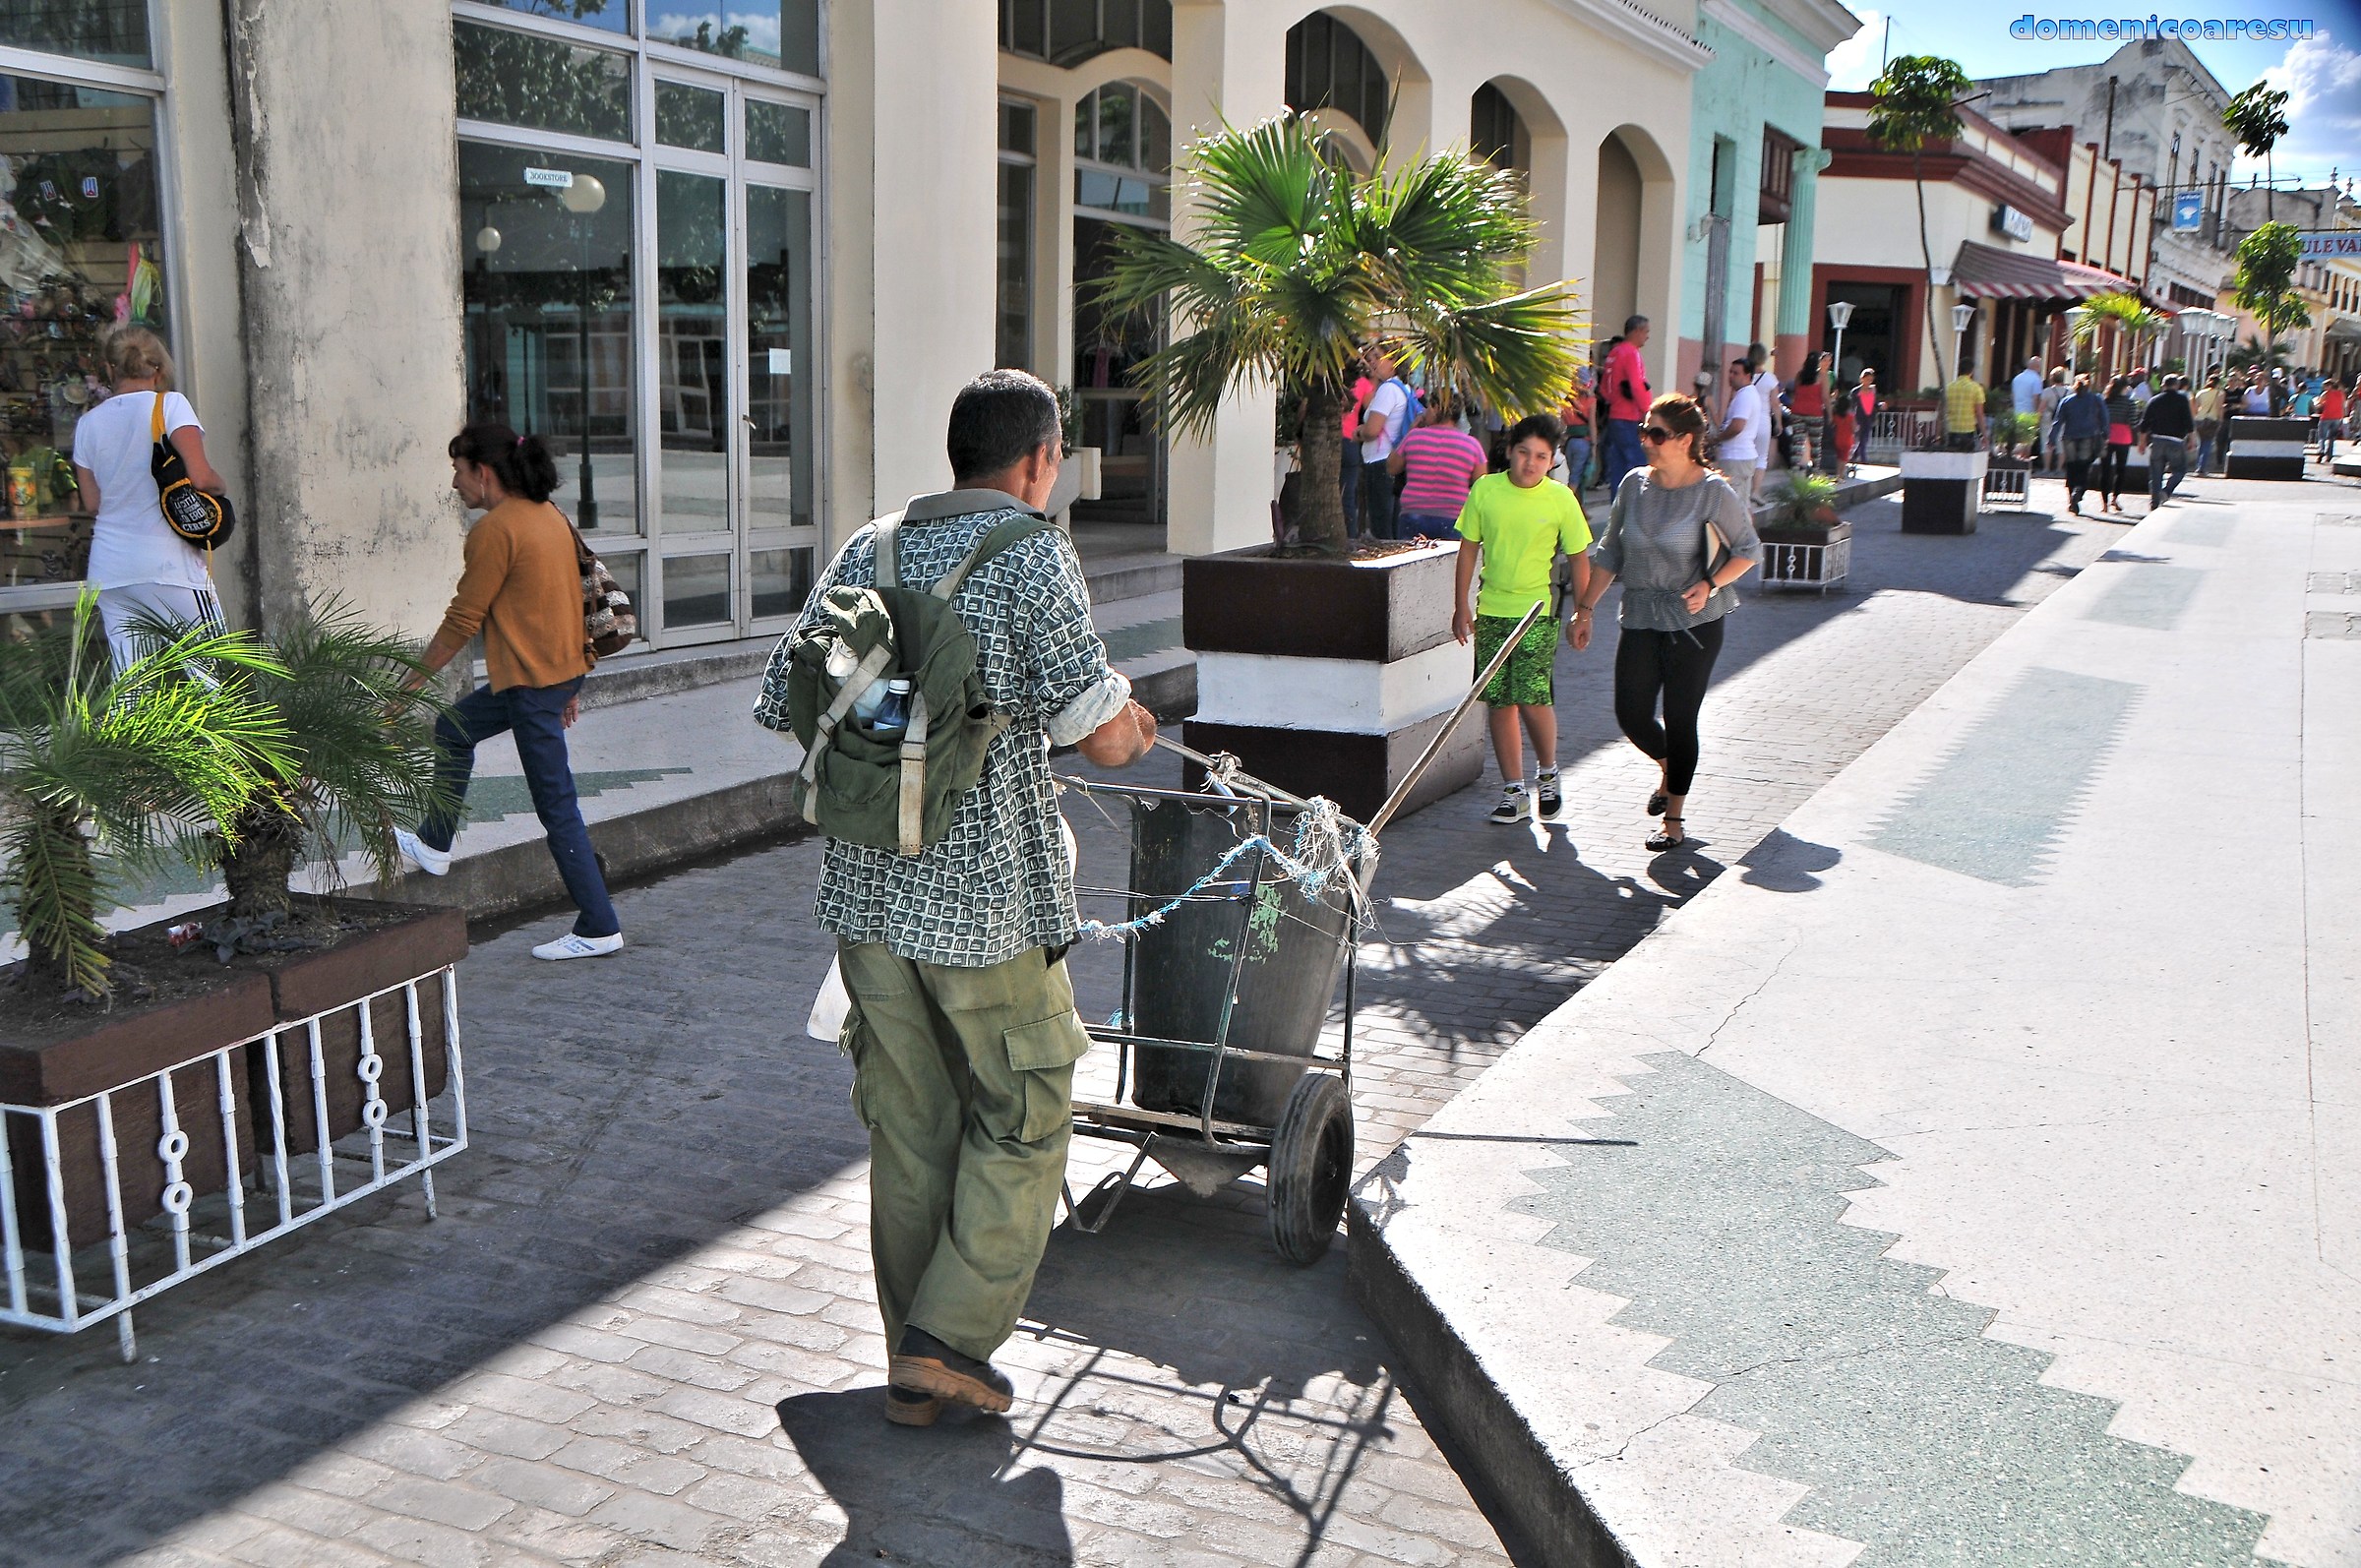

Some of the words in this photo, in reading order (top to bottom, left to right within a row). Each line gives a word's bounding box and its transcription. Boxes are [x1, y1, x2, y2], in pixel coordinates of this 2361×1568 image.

[529, 171, 568, 182] BOOKSTORE
[2300, 238, 2361, 254] ULEVA
[182, 518, 212, 531] CERES
